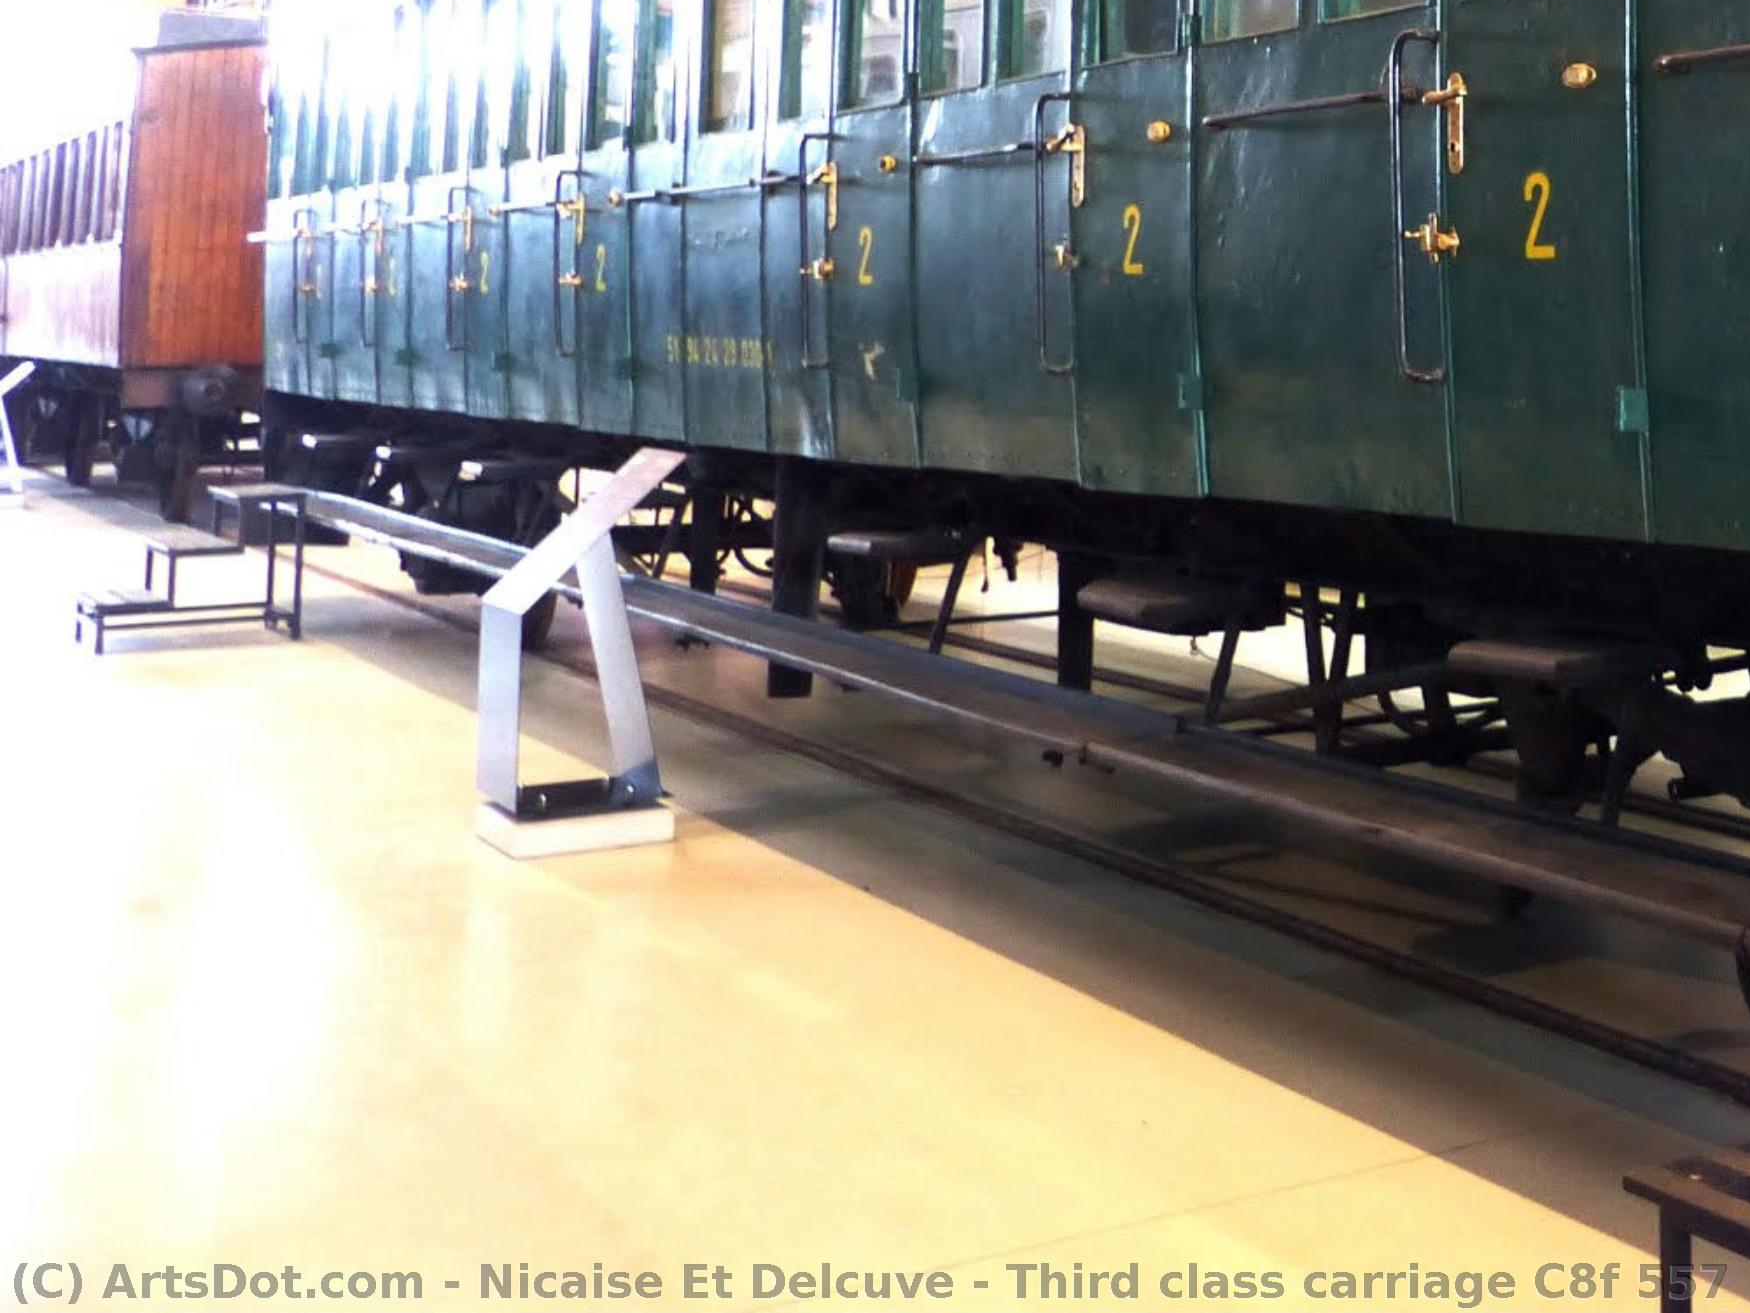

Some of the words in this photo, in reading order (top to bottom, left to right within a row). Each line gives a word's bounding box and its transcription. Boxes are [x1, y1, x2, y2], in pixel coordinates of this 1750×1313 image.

[1121, 203, 1144, 276] 2
[1523, 172, 1556, 259] 2
[858, 226, 874, 285] 2
